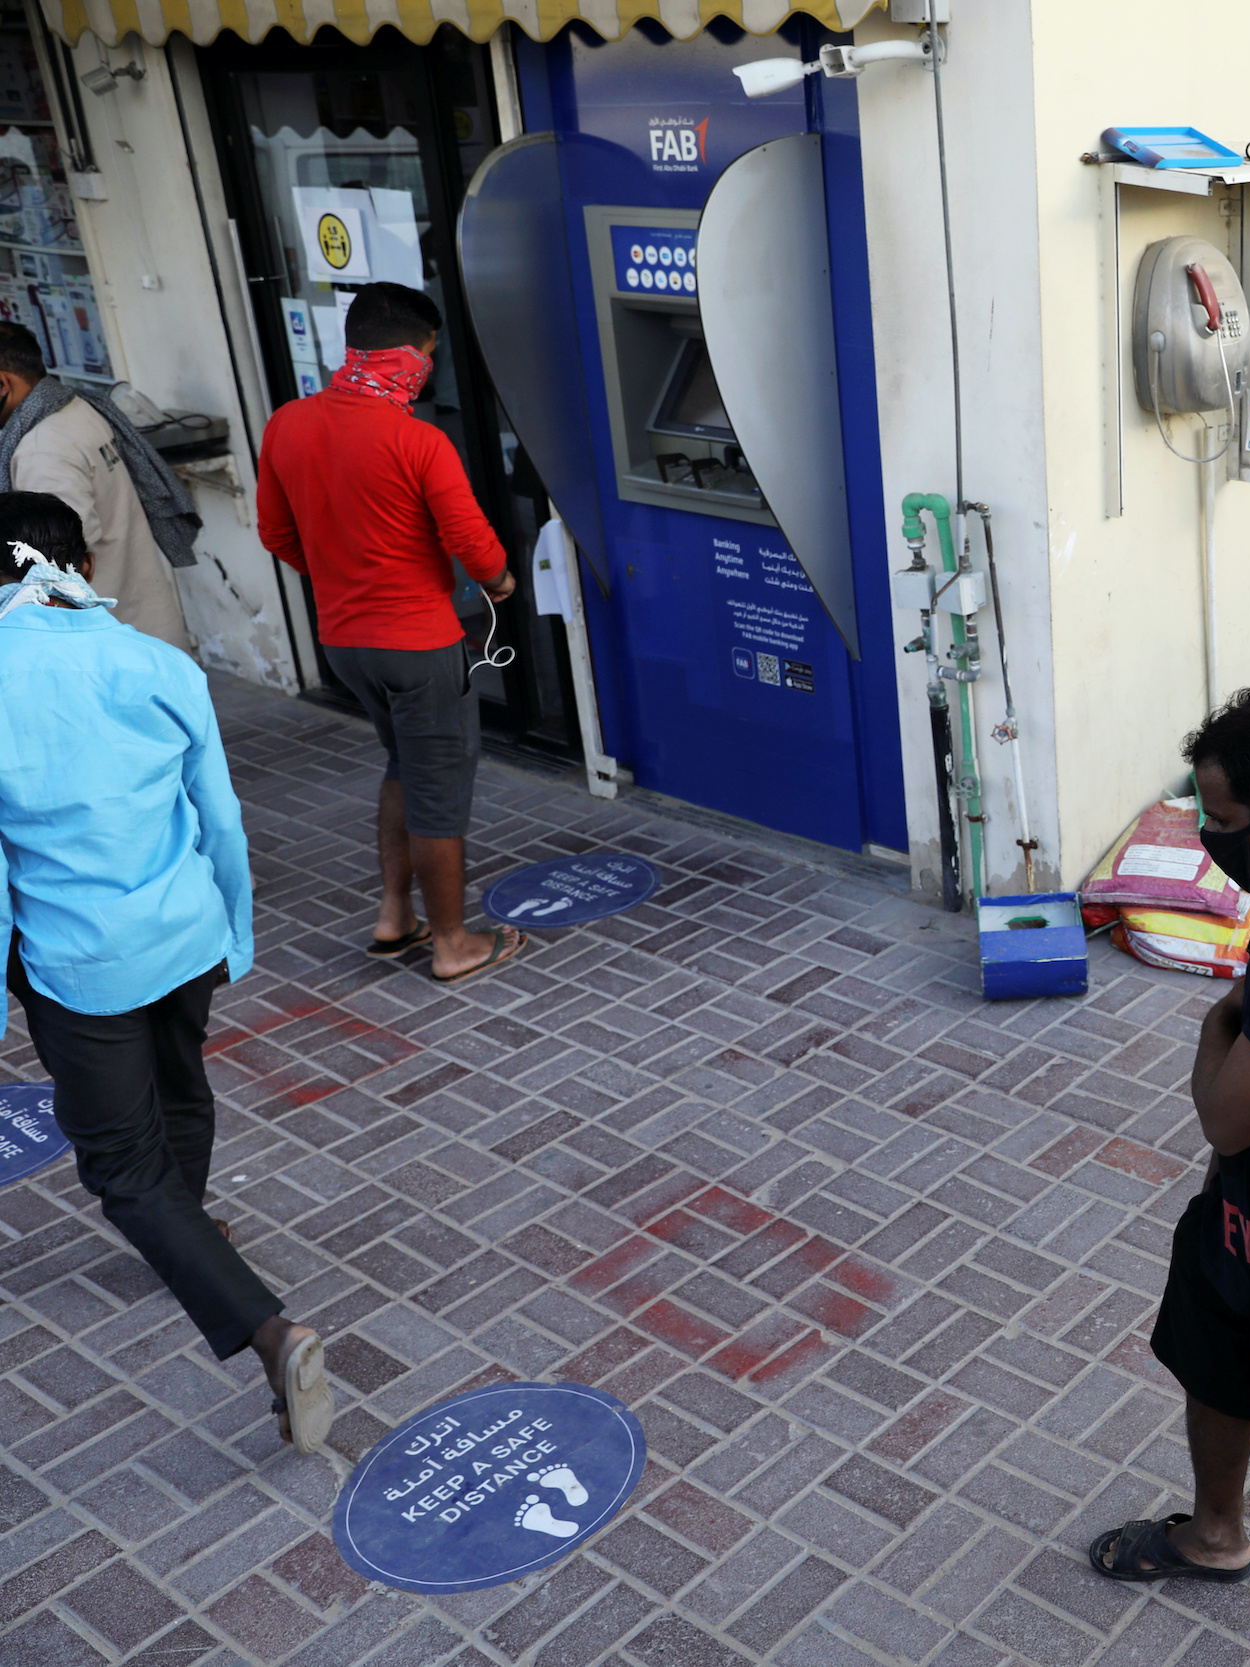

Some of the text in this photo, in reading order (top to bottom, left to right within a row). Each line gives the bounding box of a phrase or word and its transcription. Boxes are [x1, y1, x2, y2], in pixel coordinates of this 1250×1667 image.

[650, 129, 698, 161] FAB
[713, 538, 741, 553] Banking
[715, 552, 743, 565] Anytime
[717, 566, 749, 579] Anywhere
[541, 879, 599, 902] DISTANCE
[548, 870, 581, 882] KEEP
[588, 884, 620, 897] SAFE
[405, 1416, 461, 1455] اترك
[383, 1409, 523, 1501] مسافة آمنة
[401, 1417, 553, 1522] KEEP A SAFE
[439, 1439, 557, 1523] DISTANCE
